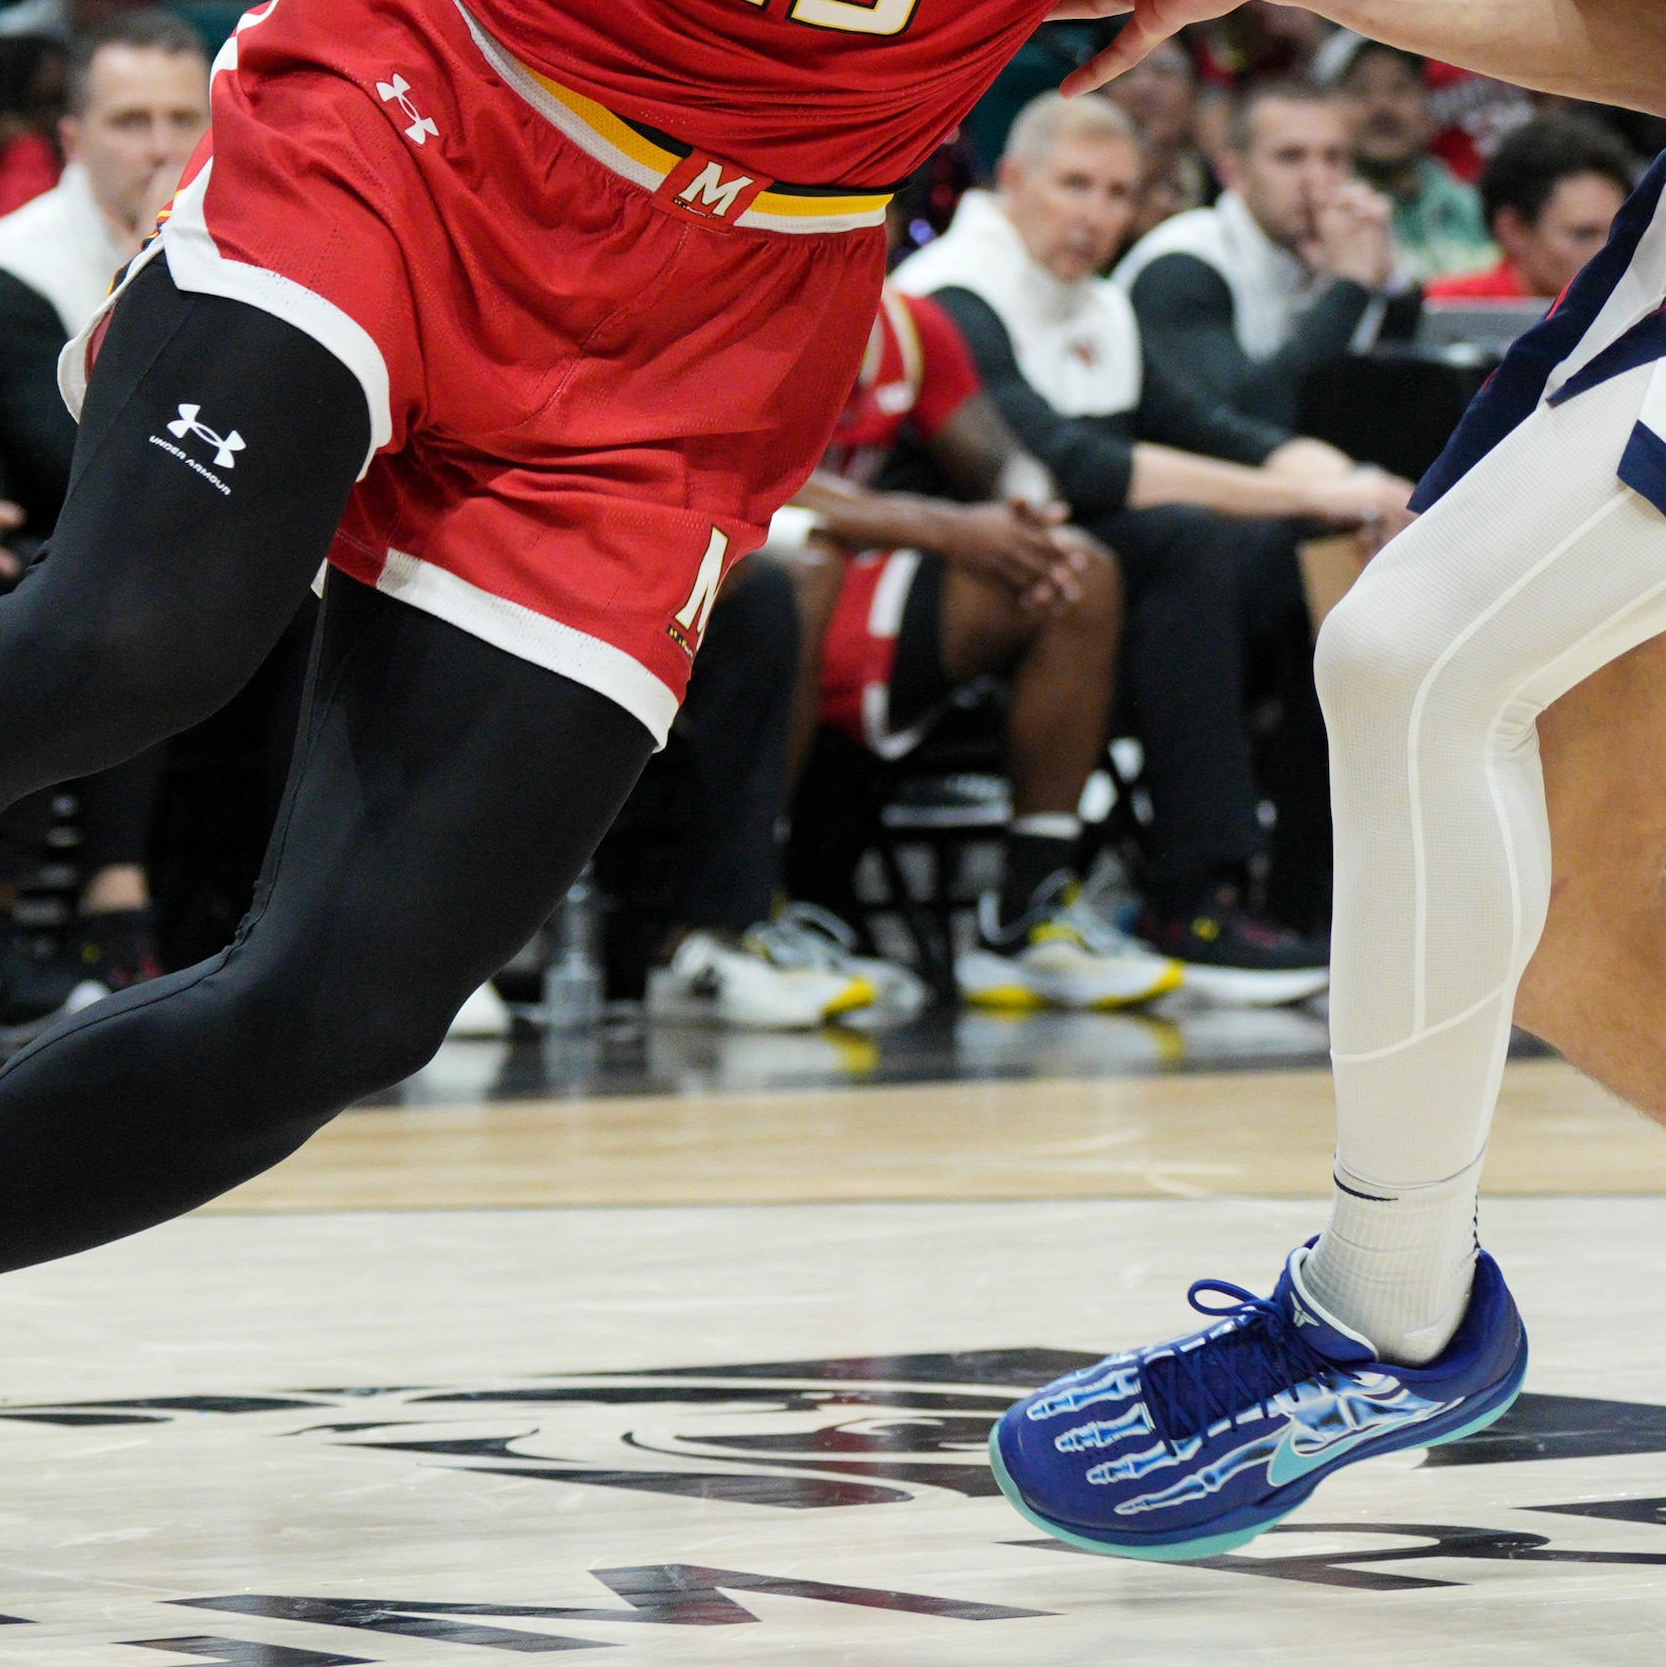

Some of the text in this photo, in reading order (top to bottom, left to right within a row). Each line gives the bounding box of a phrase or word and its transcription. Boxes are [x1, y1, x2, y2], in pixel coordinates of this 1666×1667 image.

[676, 159, 756, 217] M
[149, 435, 231, 496] UNDER ARMOUR
